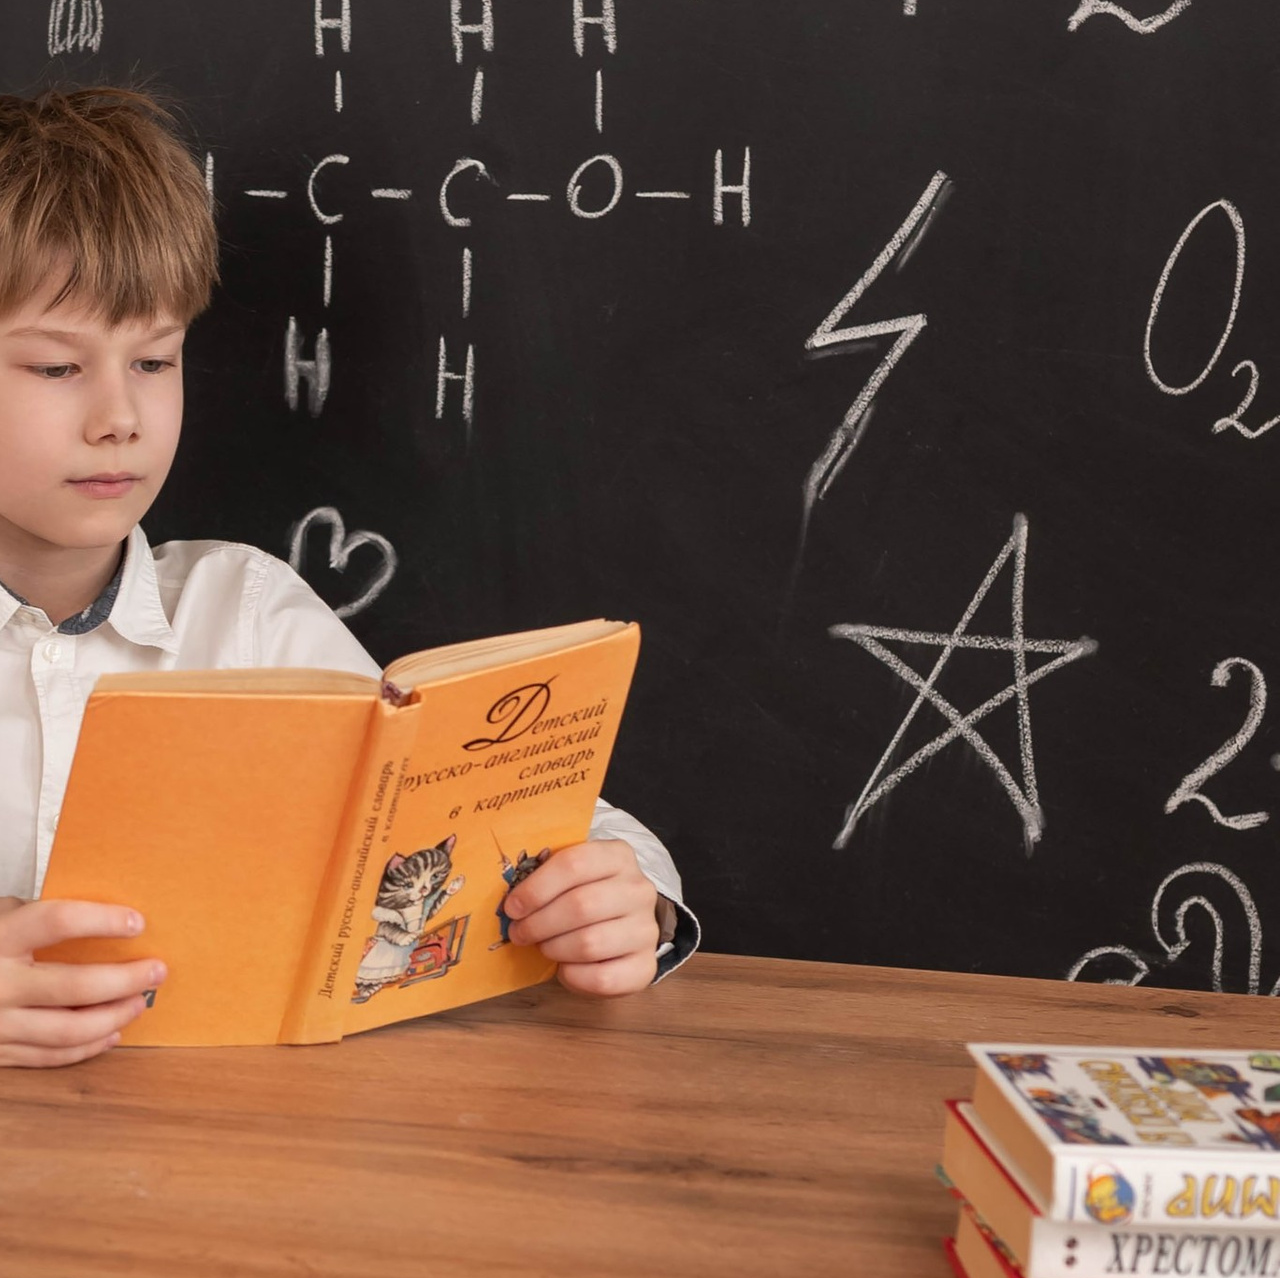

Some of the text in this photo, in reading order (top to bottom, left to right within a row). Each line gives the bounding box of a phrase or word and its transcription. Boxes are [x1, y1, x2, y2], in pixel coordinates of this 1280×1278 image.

[461, 674, 609, 752] Детский
[404, 722, 603, 792] русско-английский
[518, 748, 595, 781] словарь
[449, 769, 591, 819] в картинках
[317, 760, 394, 999] Детский русско-английский словарь
[1106, 1233, 1280, 1277] ХРЕСТОМ
